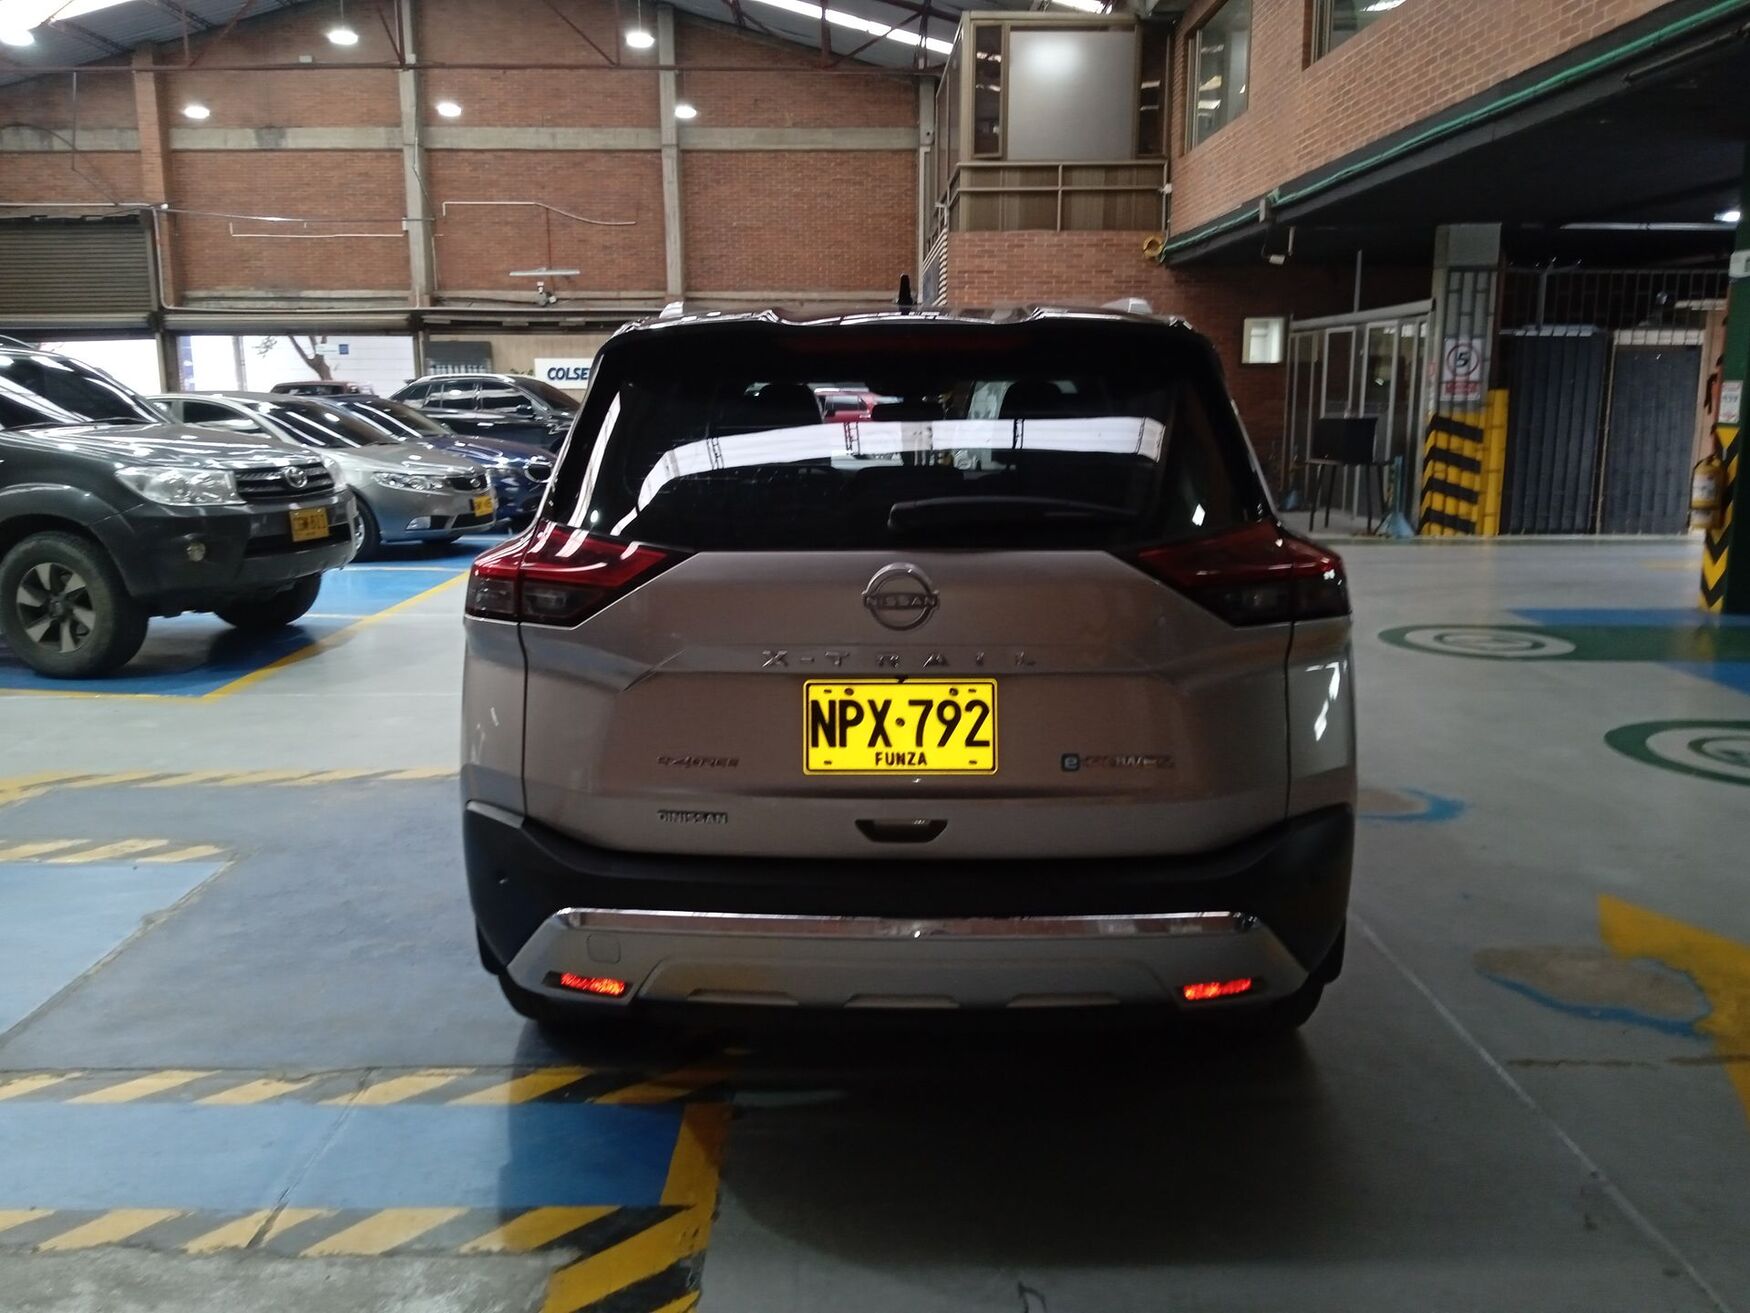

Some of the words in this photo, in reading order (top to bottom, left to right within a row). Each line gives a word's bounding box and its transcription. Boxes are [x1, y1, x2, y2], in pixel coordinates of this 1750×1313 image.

[547, 367, 590, 380] COLSE
[761, 650, 1036, 668] X-TRAIL
[875, 752, 928, 766] FUNZA
